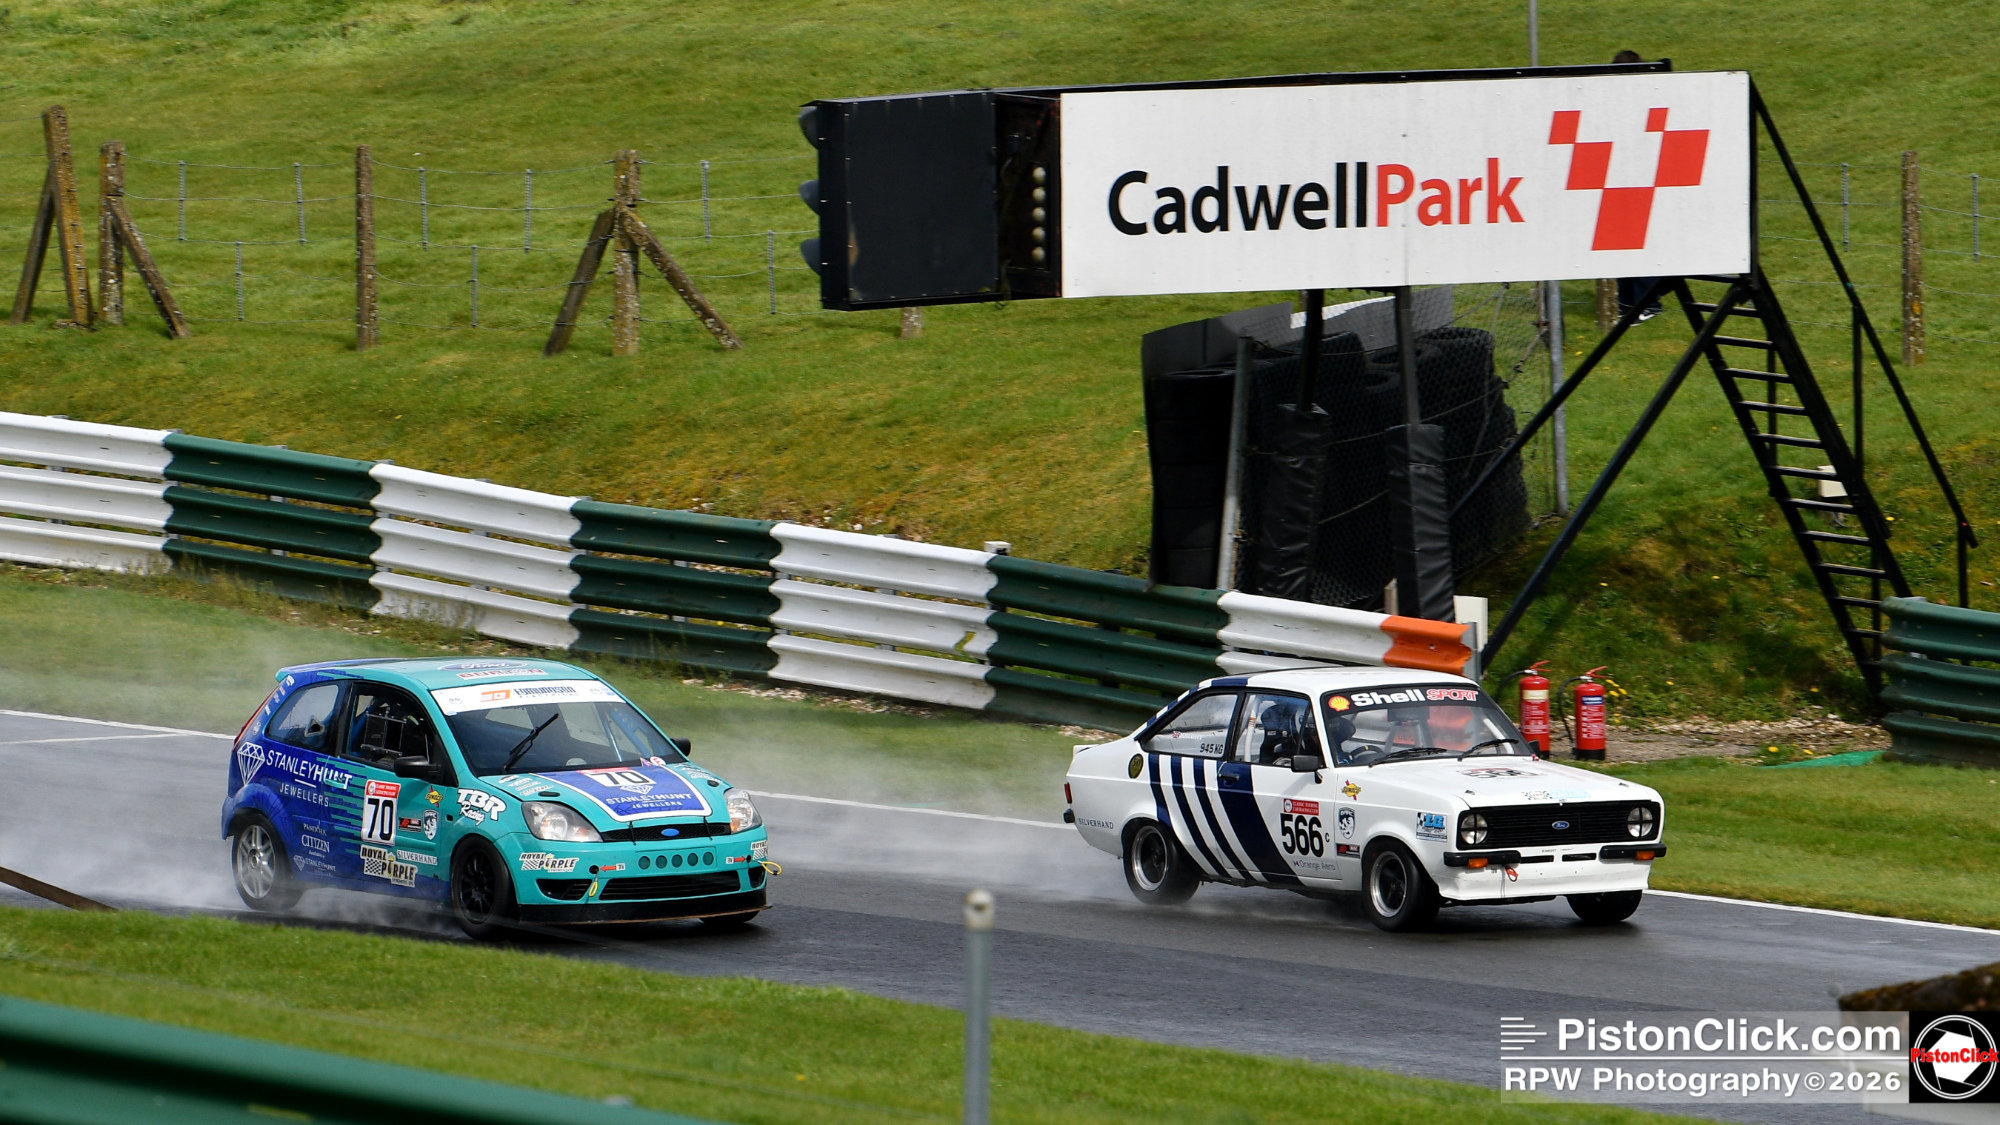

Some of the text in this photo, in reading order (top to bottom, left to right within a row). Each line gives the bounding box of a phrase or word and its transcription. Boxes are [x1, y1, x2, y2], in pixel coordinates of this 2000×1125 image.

[1350, 689, 1479, 707] Shell SPORT
[590, 771, 650, 785] 70
[279, 782, 329, 807] JEWELLERS
[606, 793, 693, 805] STANLEYHUNT
[457, 788, 507, 821] TBR
[632, 801, 683, 809] JEWELLERS
[367, 797, 394, 841] 70
[1078, 818, 1114, 830] SILVERHAND
[1280, 812, 1325, 857] 566
[301, 834, 330, 853] CITIZEN
[361, 847, 387, 861] ROYAL
[397, 850, 437, 865] SILVERHAND
[381, 861, 415, 881] PURPLE
[538, 858, 576, 869] PURPLE
